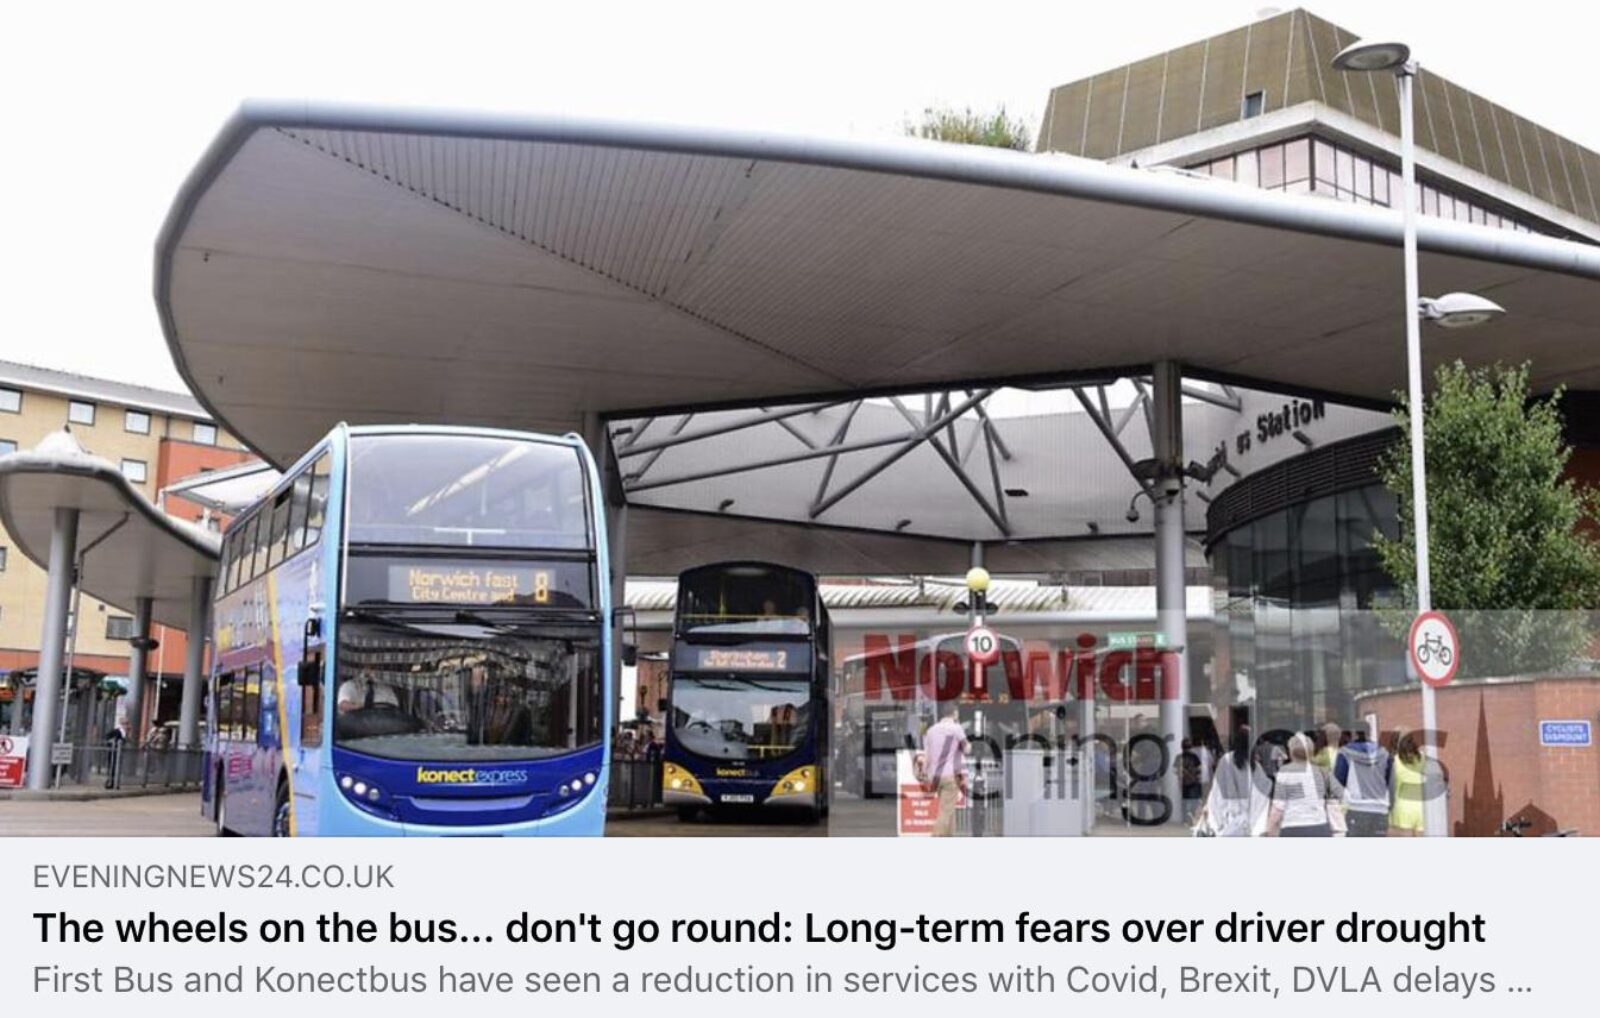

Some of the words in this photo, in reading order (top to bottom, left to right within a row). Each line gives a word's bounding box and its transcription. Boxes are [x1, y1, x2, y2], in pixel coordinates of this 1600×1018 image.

[1257, 399, 1325, 443] Station
[409, 568, 480, 588] Norwich
[485, 570, 519, 588] fast
[534, 570, 549, 603] 8
[411, 586, 440, 601] City
[440, 587, 488, 601] Centre
[972, 636, 993, 652] 10
[777, 650, 787, 669] 2
